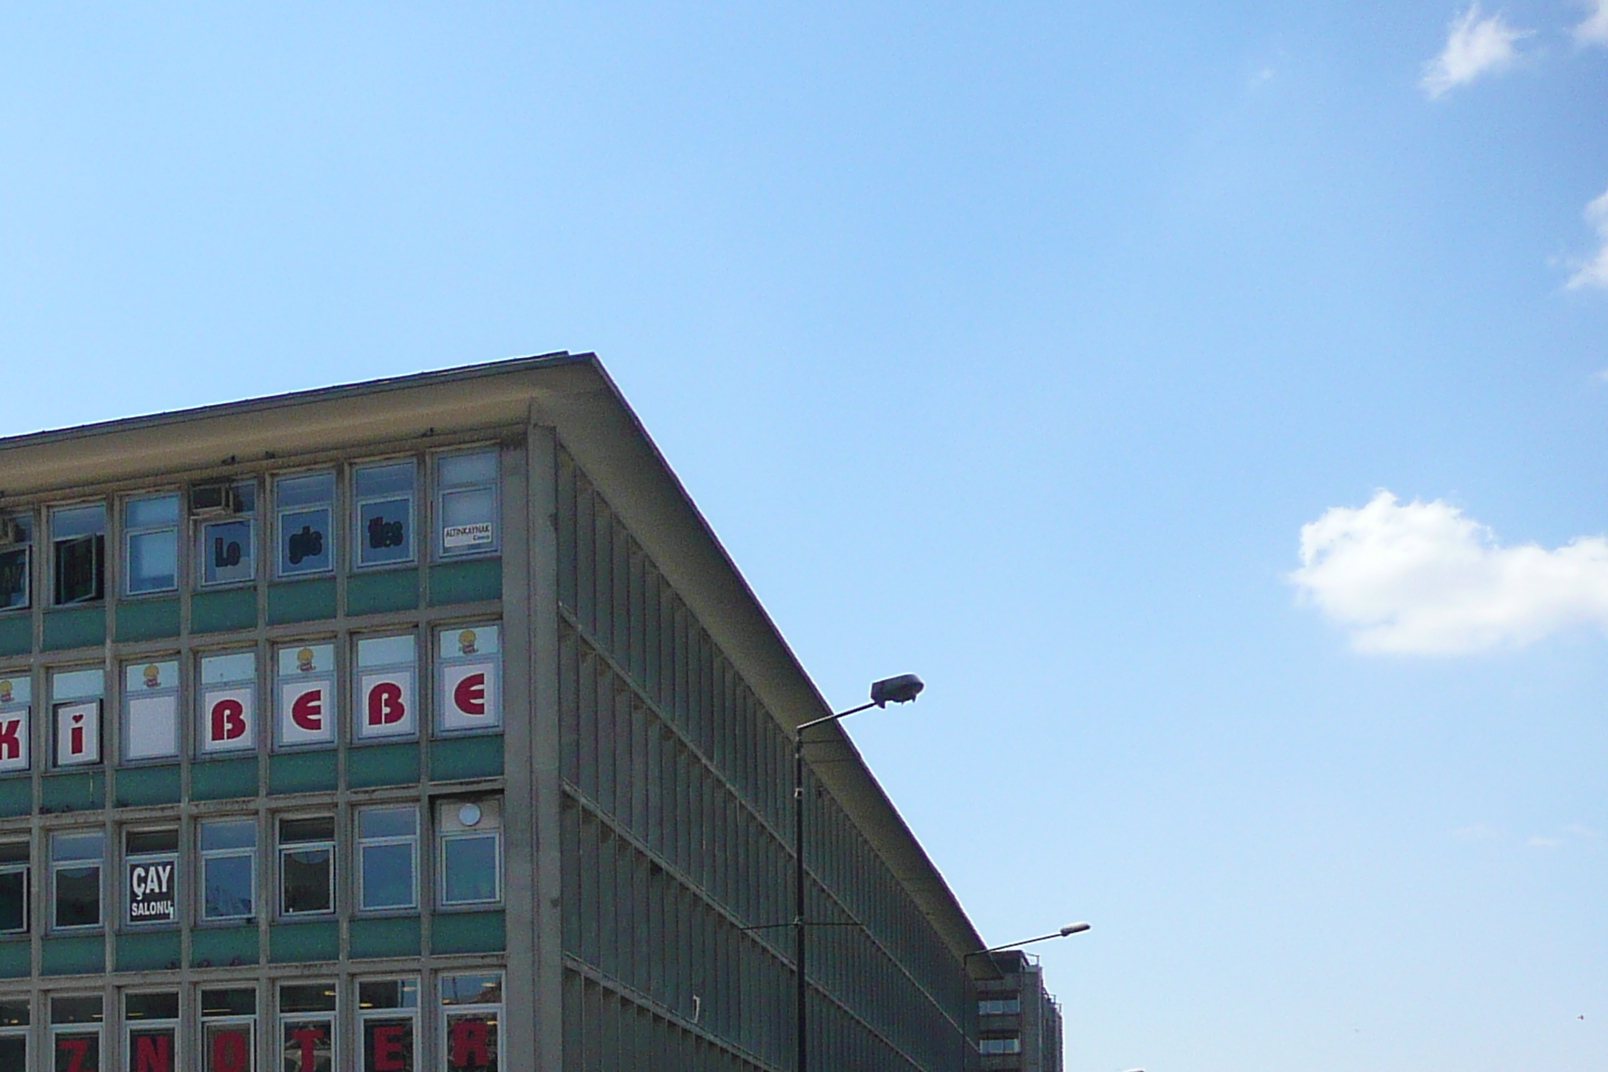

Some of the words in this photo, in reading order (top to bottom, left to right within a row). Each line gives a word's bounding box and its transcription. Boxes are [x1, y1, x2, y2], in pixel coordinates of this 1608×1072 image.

[211, 672, 486, 742] BEBE
[132, 865, 172, 900] ÇAY
[131, 900, 171, 917] SALONU
